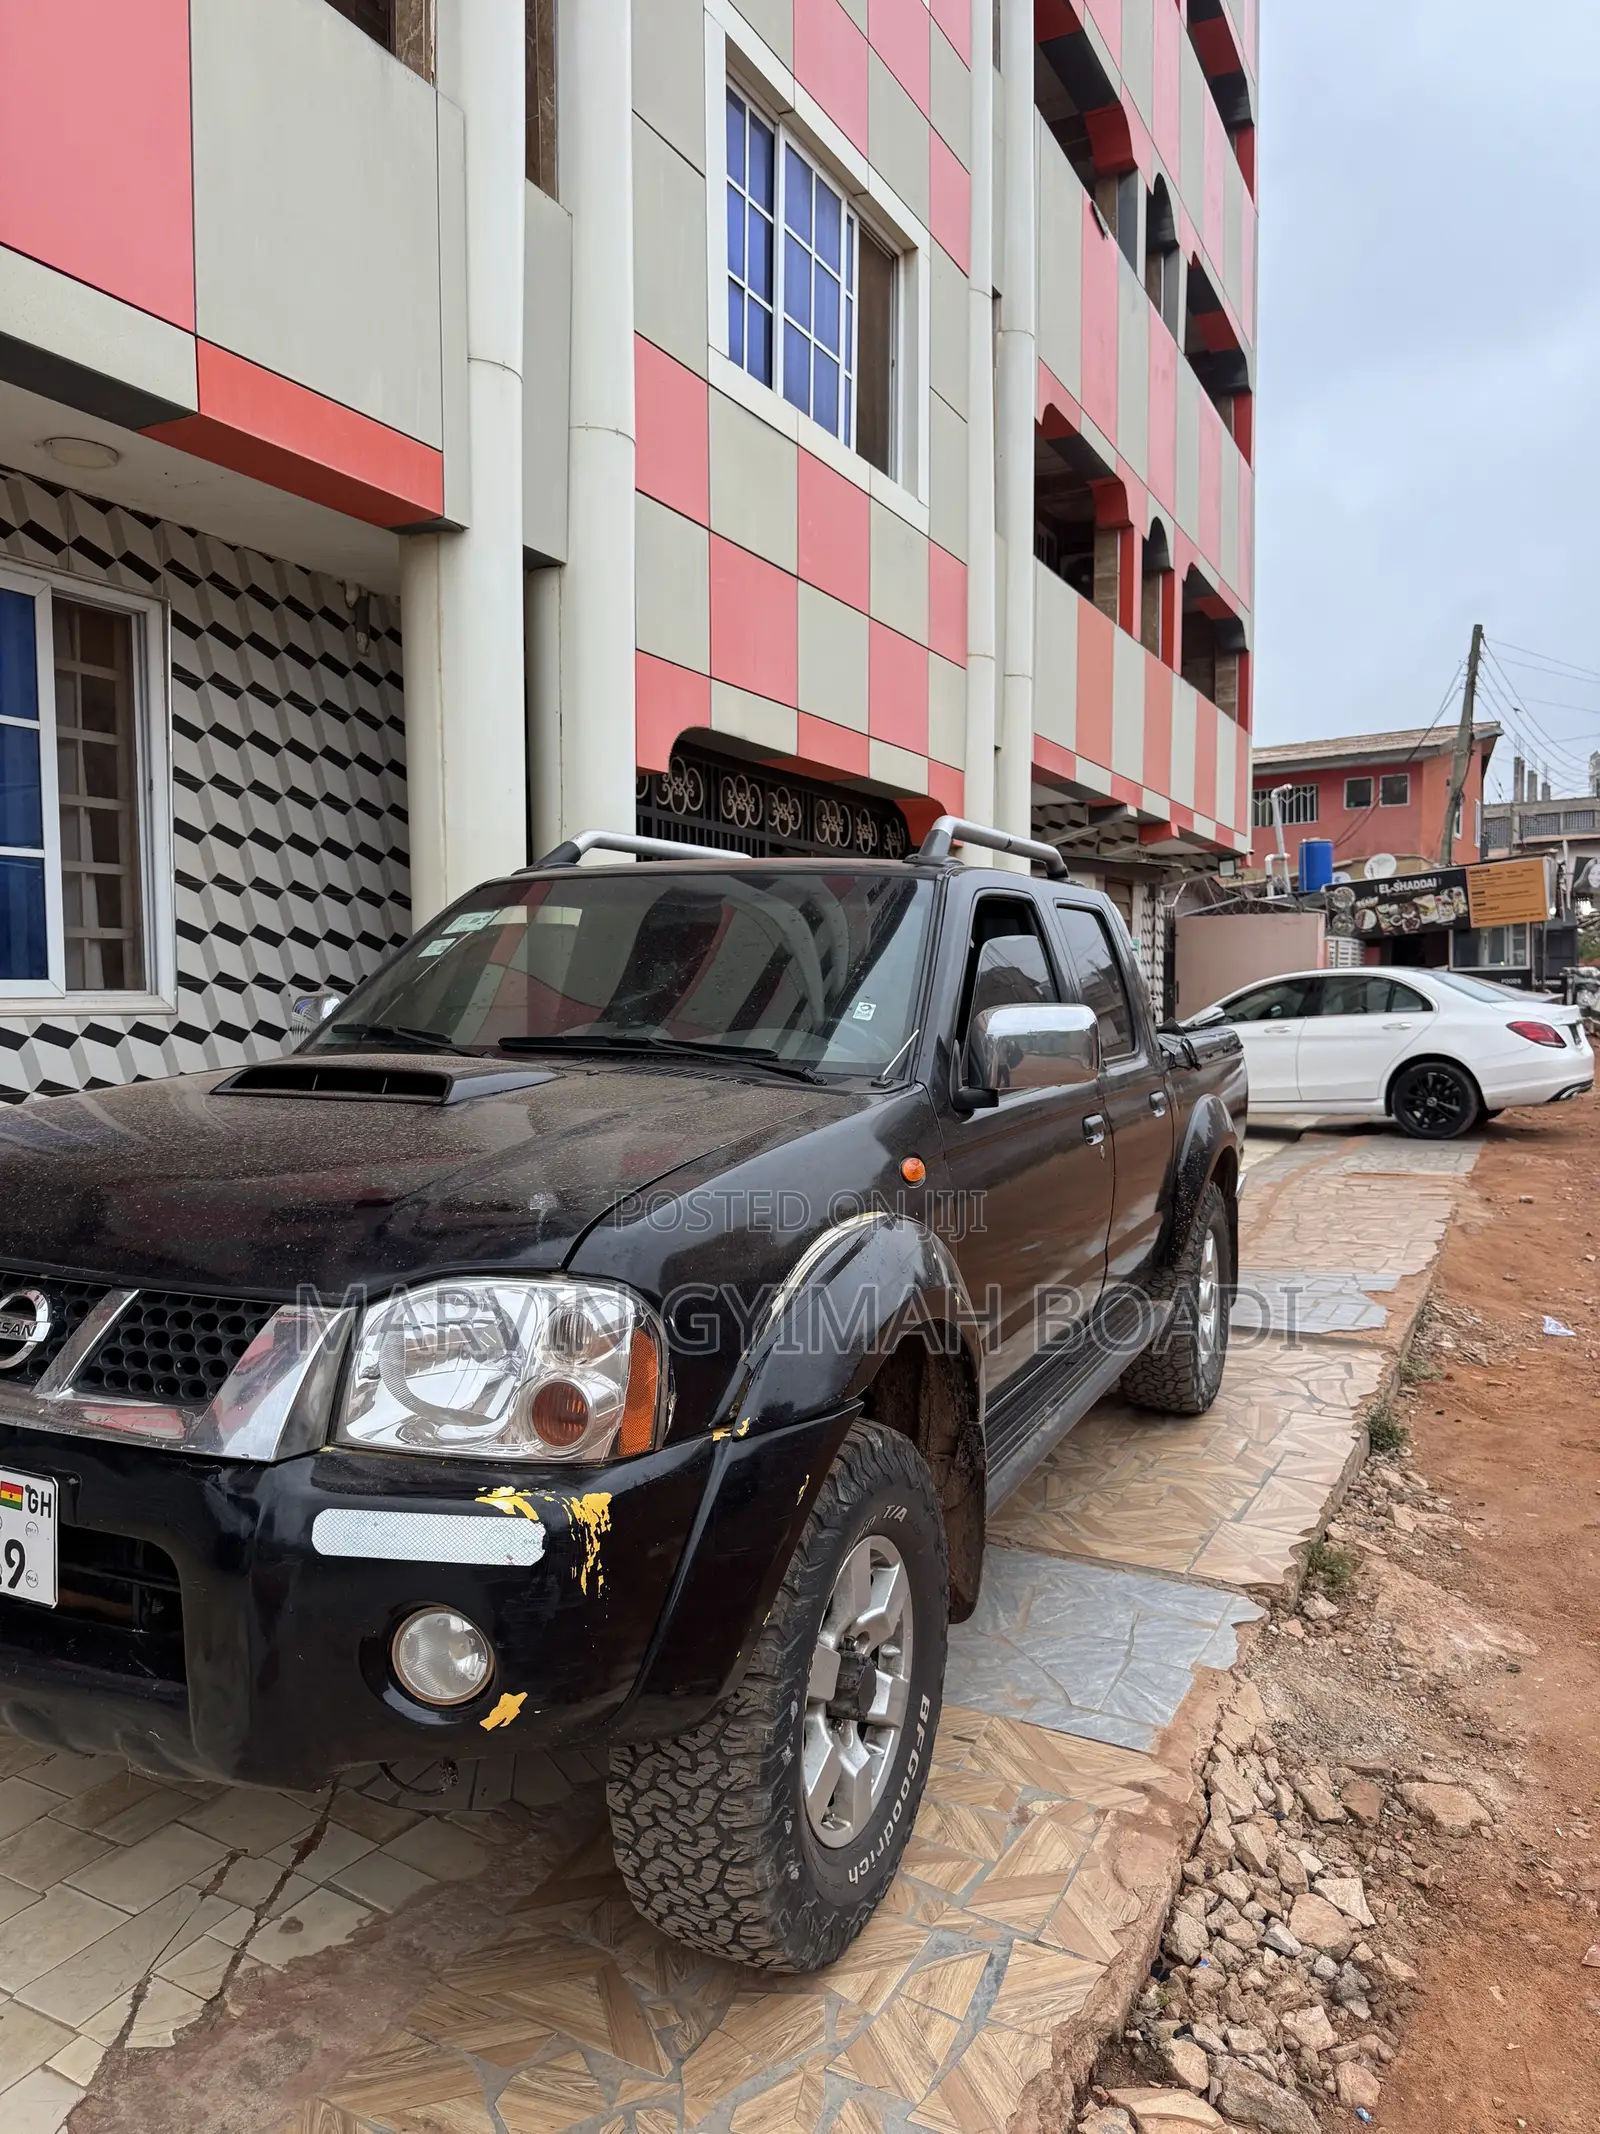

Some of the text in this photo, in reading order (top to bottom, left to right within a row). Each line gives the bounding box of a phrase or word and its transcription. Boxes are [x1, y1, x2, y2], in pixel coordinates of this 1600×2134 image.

[1378, 877, 1438, 894] EL-SHADDAI
[0, 1321, 37, 1337] SAN
[28, 1488, 51, 1519] GH
[883, 1504, 908, 1523] T/A
[0, 1538, 26, 1589] 9
[848, 1693, 931, 1885] BFGoodrich
